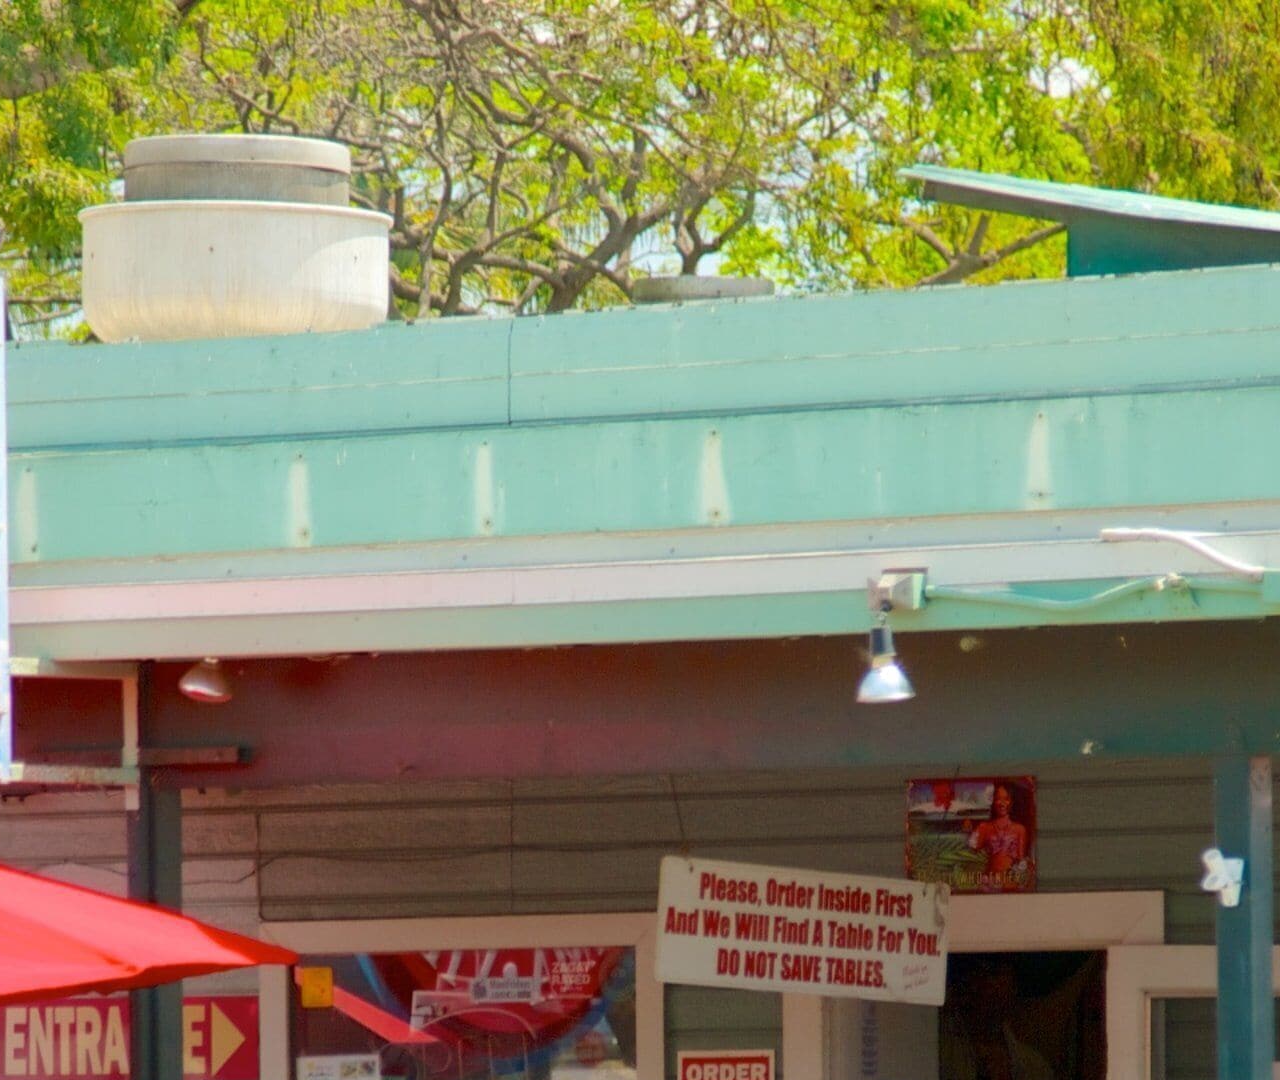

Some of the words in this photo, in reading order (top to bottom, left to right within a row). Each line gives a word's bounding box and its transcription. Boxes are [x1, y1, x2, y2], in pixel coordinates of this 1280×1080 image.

[766, 880, 815, 908] Order
[818, 883, 872, 915] Inside
[875, 888, 913, 918] First
[665, 906, 698, 937] And
[702, 910, 731, 938] We
[734, 912, 769, 940] Will
[773, 916, 809, 945] Find
[812, 922, 824, 947] A
[827, 922, 873, 950] Table
[877, 926, 905, 953] For
[907, 927, 941, 958] You.
[716, 948, 740, 977] DO
[744, 950, 777, 980] NOT
[781, 954, 822, 984] SAVE
[825, 957, 887, 989] TABLES.
[4, 1005, 207, 1076] ENTRAE
